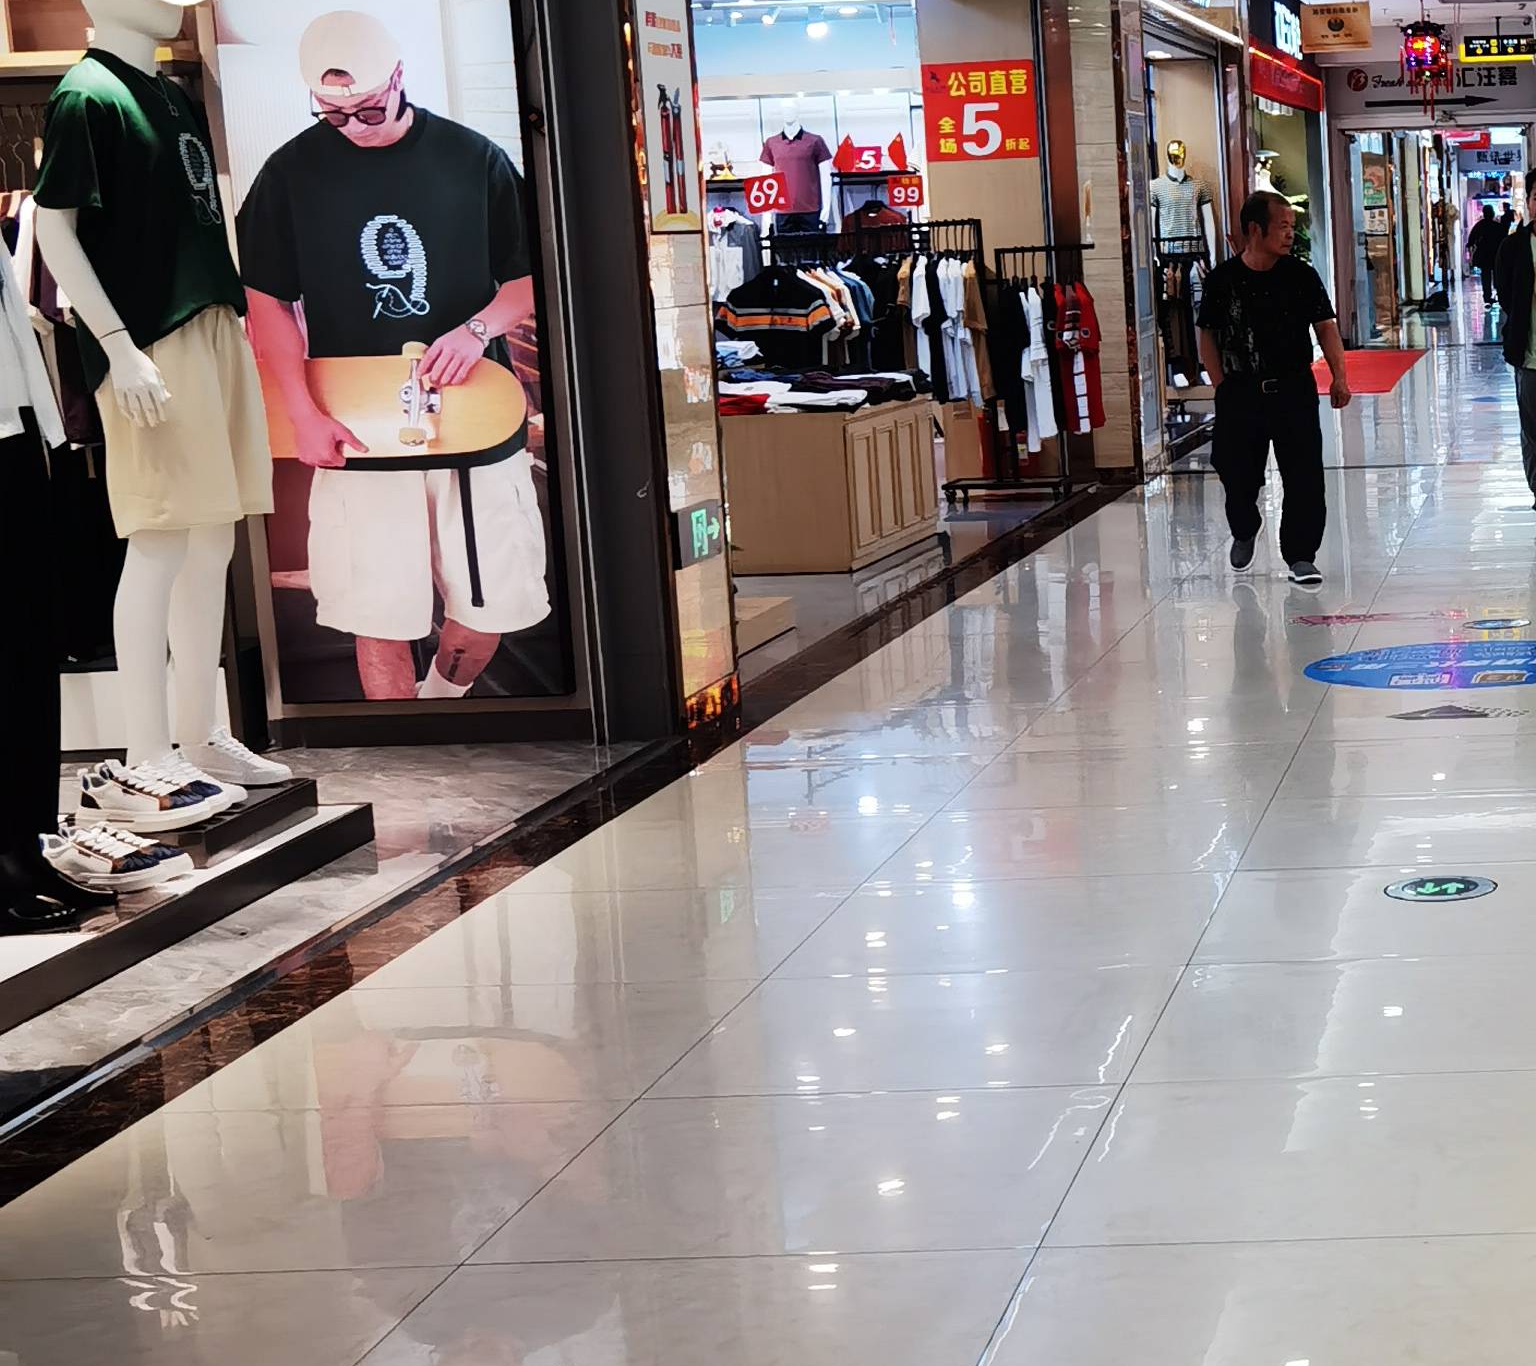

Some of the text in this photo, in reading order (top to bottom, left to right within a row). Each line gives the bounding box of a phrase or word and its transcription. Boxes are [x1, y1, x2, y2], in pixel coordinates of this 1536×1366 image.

[948, 69, 1028, 97] 公司直营
[962, 102, 1002, 157] 5
[1005, 138, 1031, 152] 折起
[893, 187, 920, 203] 99
